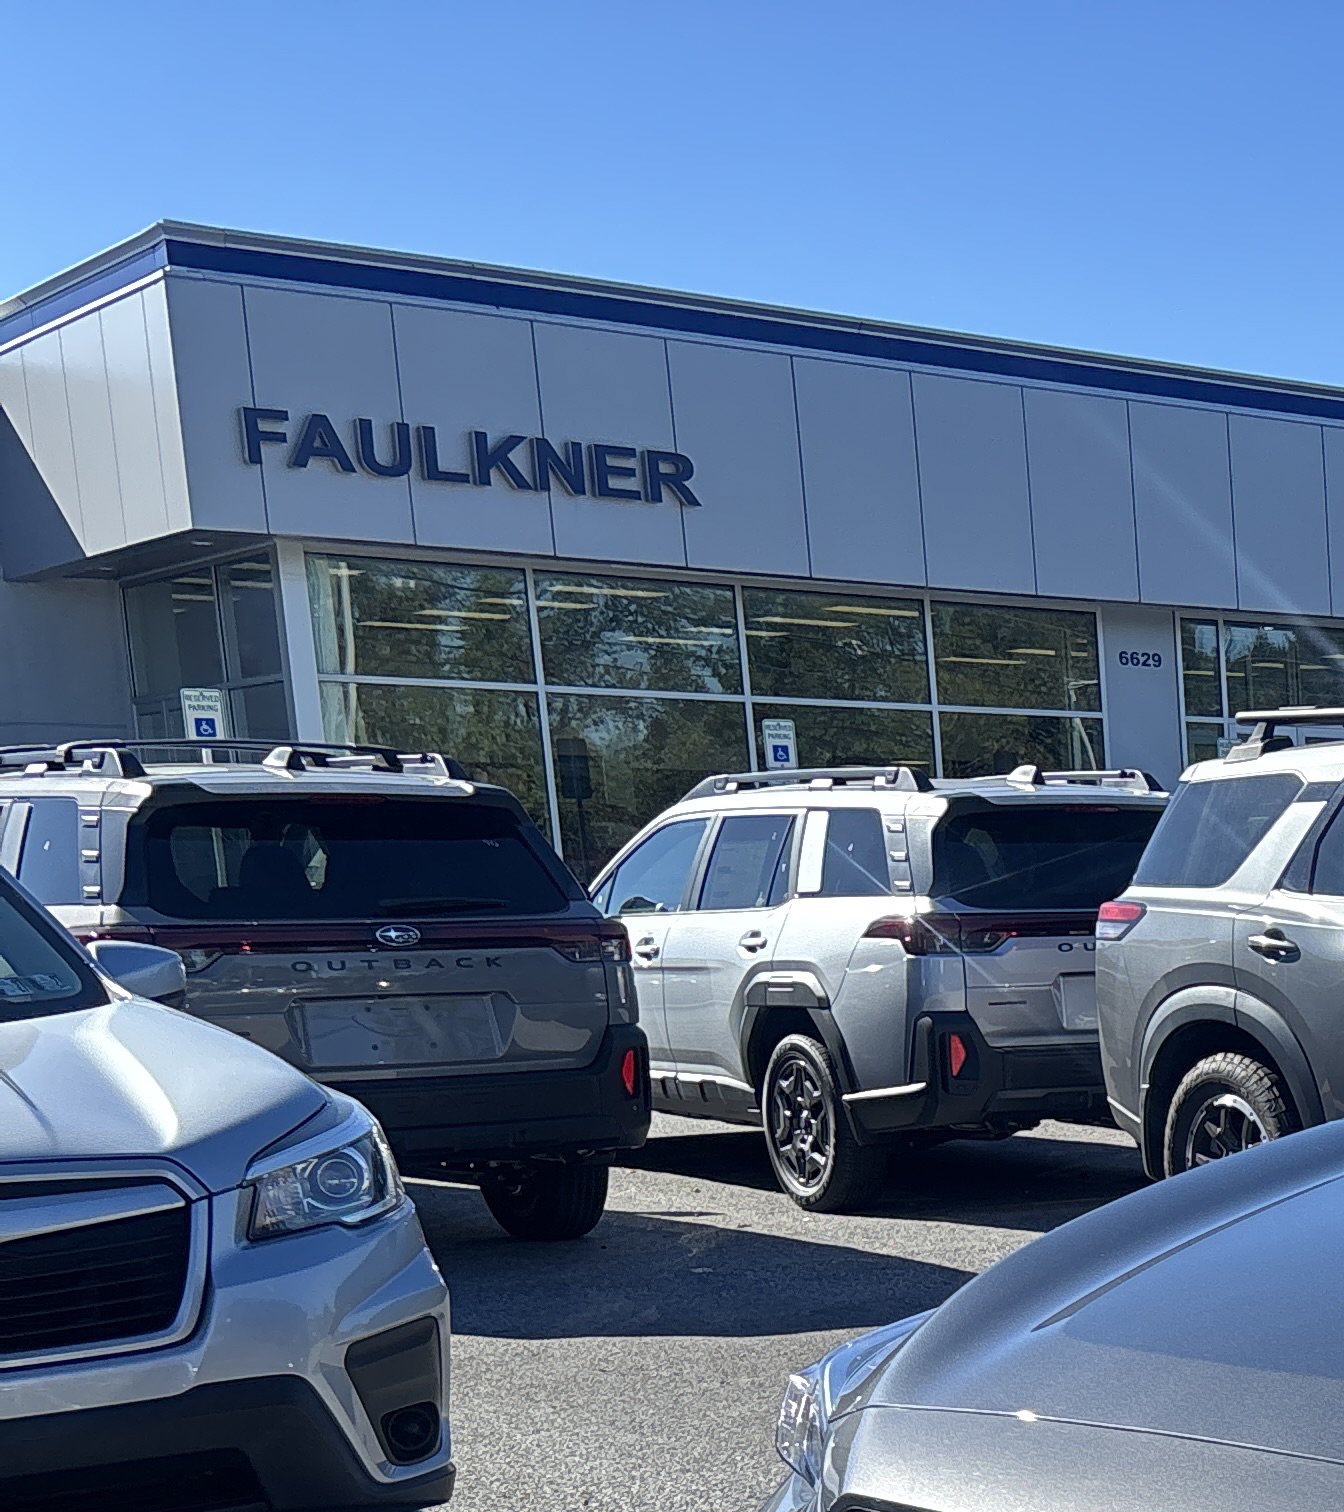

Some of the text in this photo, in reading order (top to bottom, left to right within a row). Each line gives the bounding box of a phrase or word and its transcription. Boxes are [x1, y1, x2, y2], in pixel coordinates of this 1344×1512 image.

[238, 405, 703, 507] FAULKNER
[1118, 650, 1162, 668] 6629
[290, 956, 503, 973] OUTBACK
